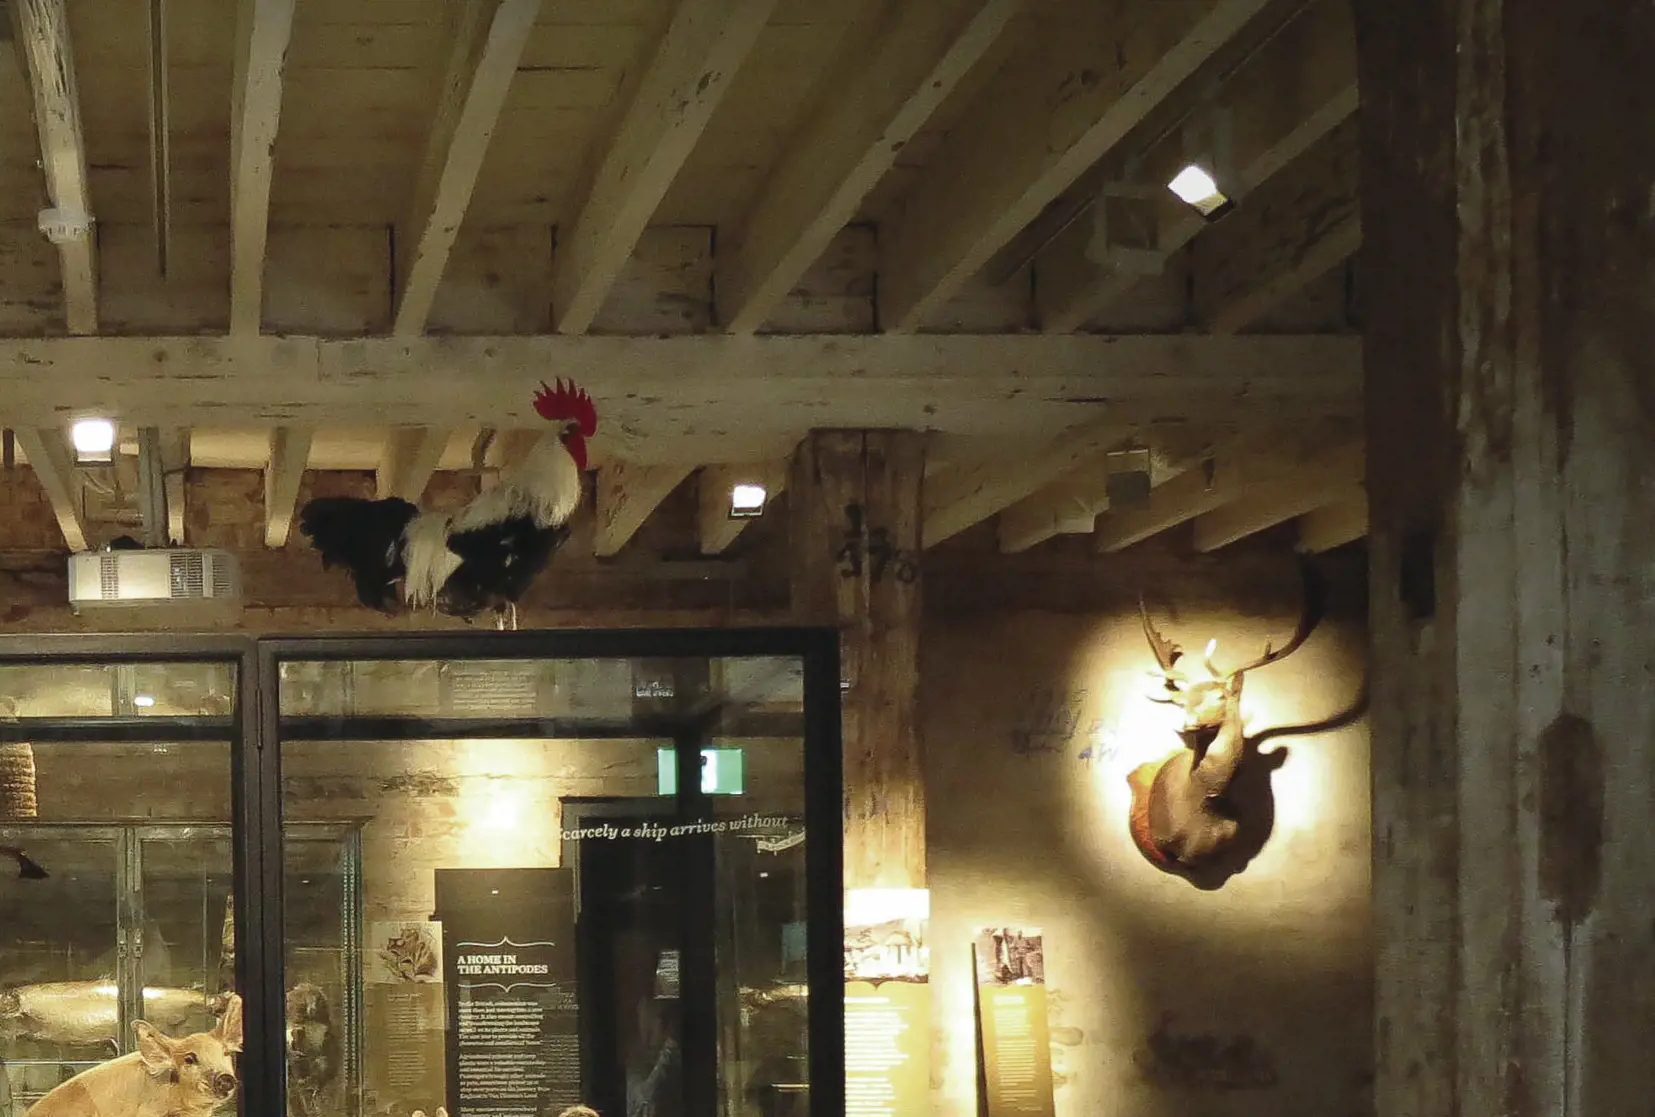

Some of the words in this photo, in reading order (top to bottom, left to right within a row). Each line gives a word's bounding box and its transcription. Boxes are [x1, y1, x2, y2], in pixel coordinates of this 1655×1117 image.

[621, 827, 631, 838] a
[633, 822, 667, 842] ship
[670, 818, 726, 836] arrives
[729, 812, 789, 830] without
[457, 955, 465, 965] A
[467, 955, 502, 965] HOME
[503, 955, 517, 965] IN
[457, 965, 482, 974] THE
[483, 965, 548, 974] ANTIPODES
